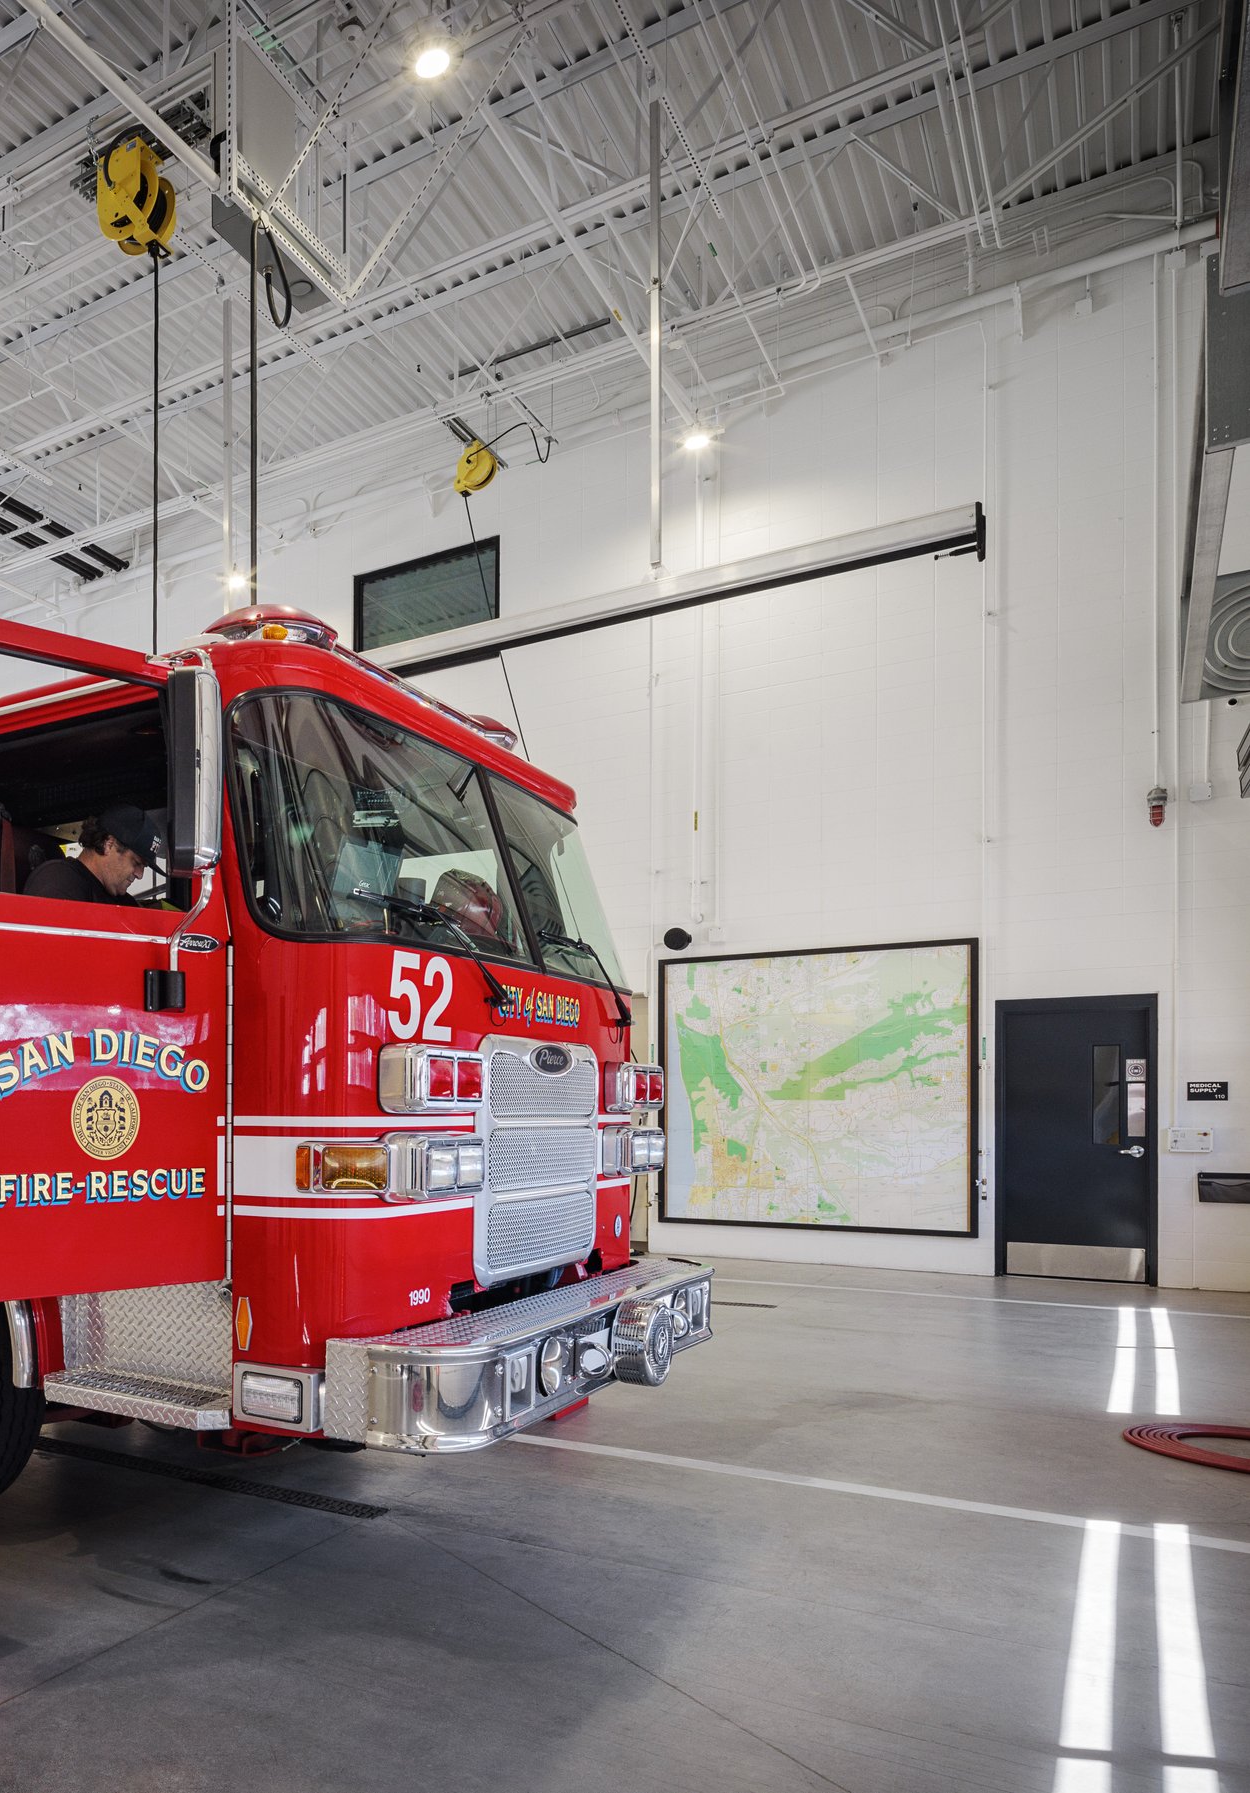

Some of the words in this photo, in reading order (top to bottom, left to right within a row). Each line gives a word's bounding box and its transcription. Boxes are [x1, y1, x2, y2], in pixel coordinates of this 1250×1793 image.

[388, 950, 453, 1042] 52
[524, 987, 535, 1027] of
[535, 991, 554, 1023] SAN
[555, 995, 580, 1028] DIEGO
[88, 1028, 210, 1094] DIEGO
[539, 1048, 565, 1066] Pierce
[80, 1089, 91, 1103] SAN
[89, 1081, 107, 1091] DIEGO
[109, 1081, 124, 1093] STATE
[409, 1287, 430, 1306] 1990
